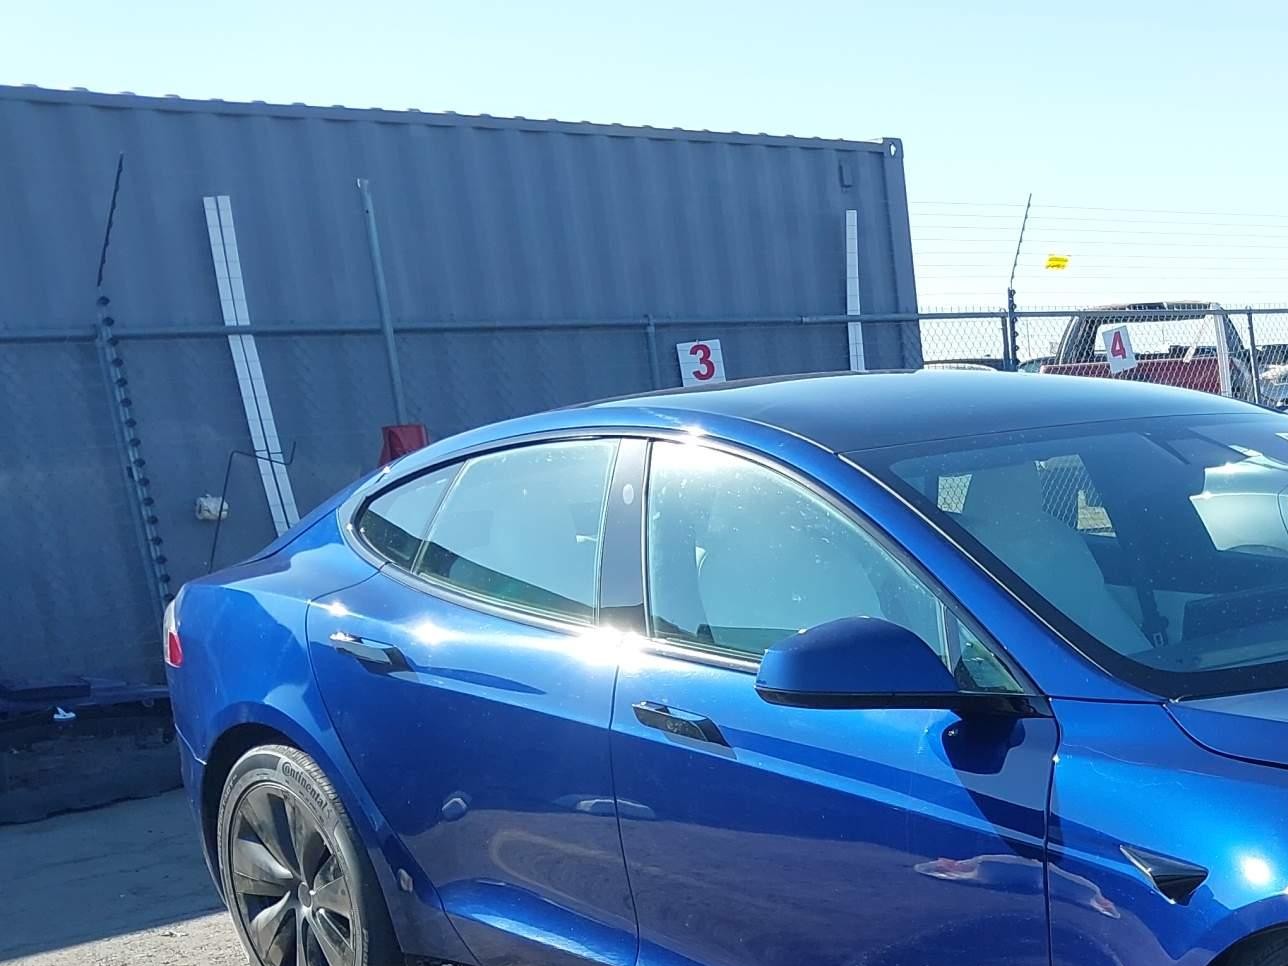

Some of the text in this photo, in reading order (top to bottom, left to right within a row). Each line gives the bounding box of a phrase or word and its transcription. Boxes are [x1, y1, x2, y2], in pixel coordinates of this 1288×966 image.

[690, 344, 715, 381] 3
[1110, 331, 1127, 359] 4
[282, 761, 328, 811] Continental
